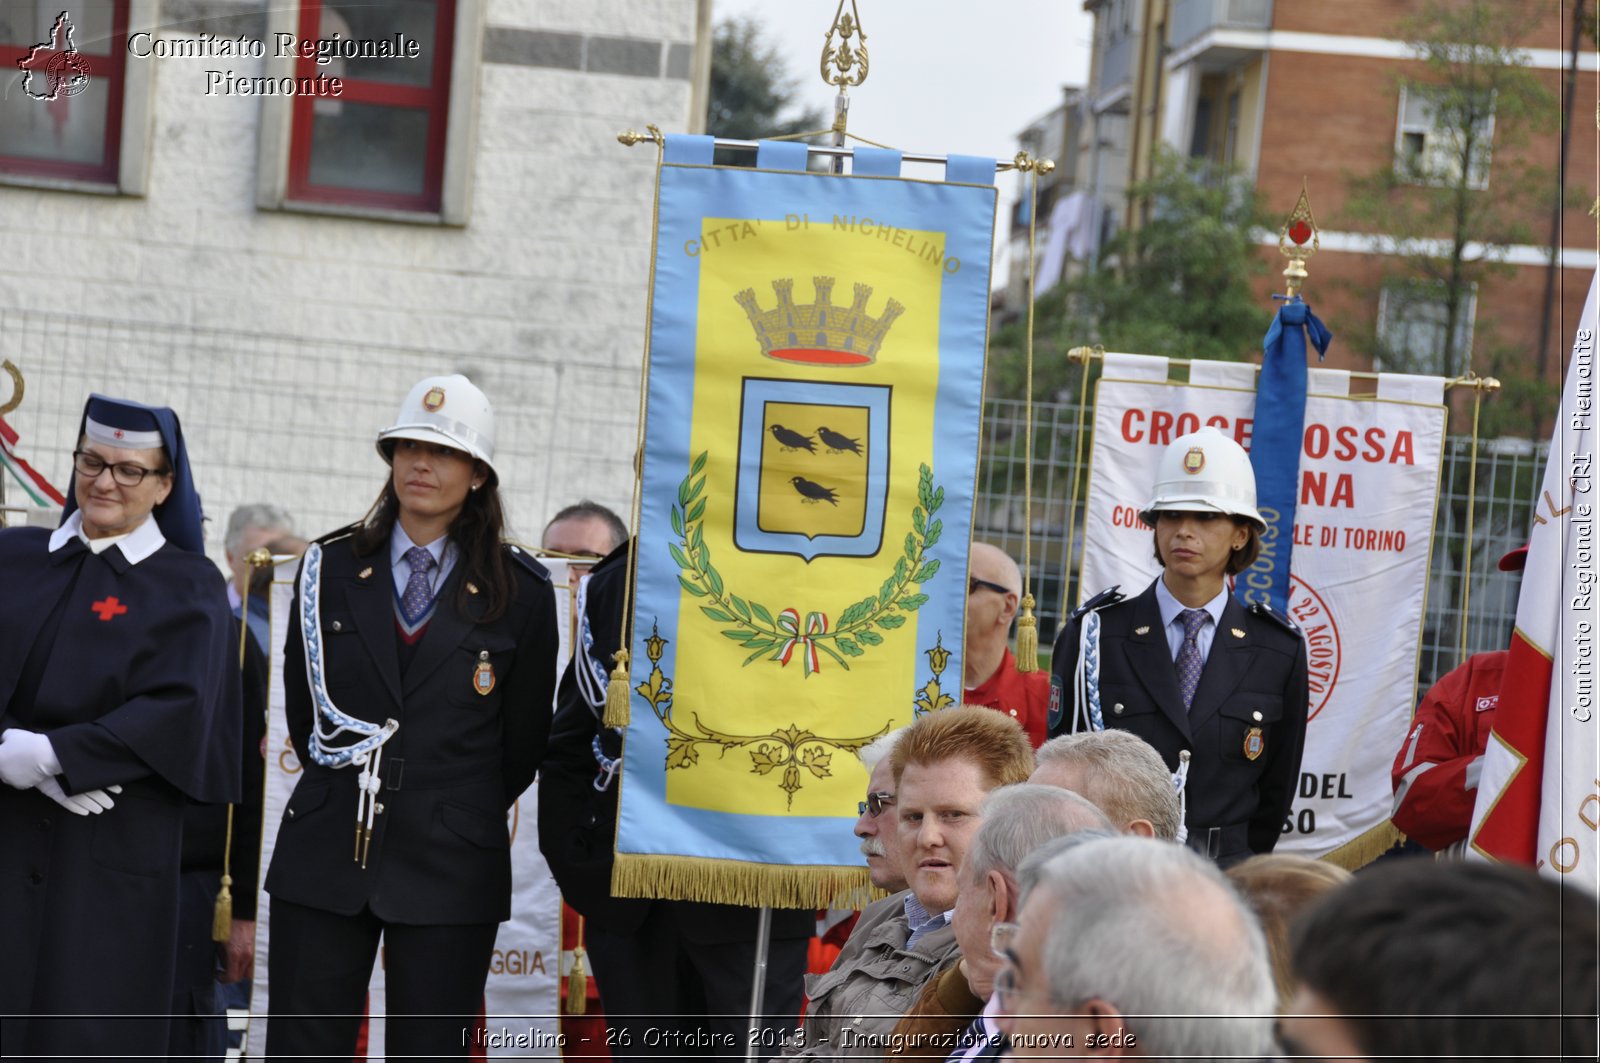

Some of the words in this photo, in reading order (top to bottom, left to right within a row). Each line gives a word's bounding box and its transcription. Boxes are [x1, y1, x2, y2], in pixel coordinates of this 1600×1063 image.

[683, 218, 761, 258] CITTA'
[784, 213, 810, 231] DI
[832, 214, 961, 275] NICHELINO
[1304, 423, 1416, 466] OSSA
[1243, 506, 1281, 605] CCORSO
[1320, 526, 1338, 547] DI
[1343, 527, 1406, 552] TORINO
[1291, 597, 1320, 622] 22
[1304, 624, 1334, 694] AGOSTO
[1299, 772, 1353, 800] DEL
[490, 949, 546, 975] GGIA
